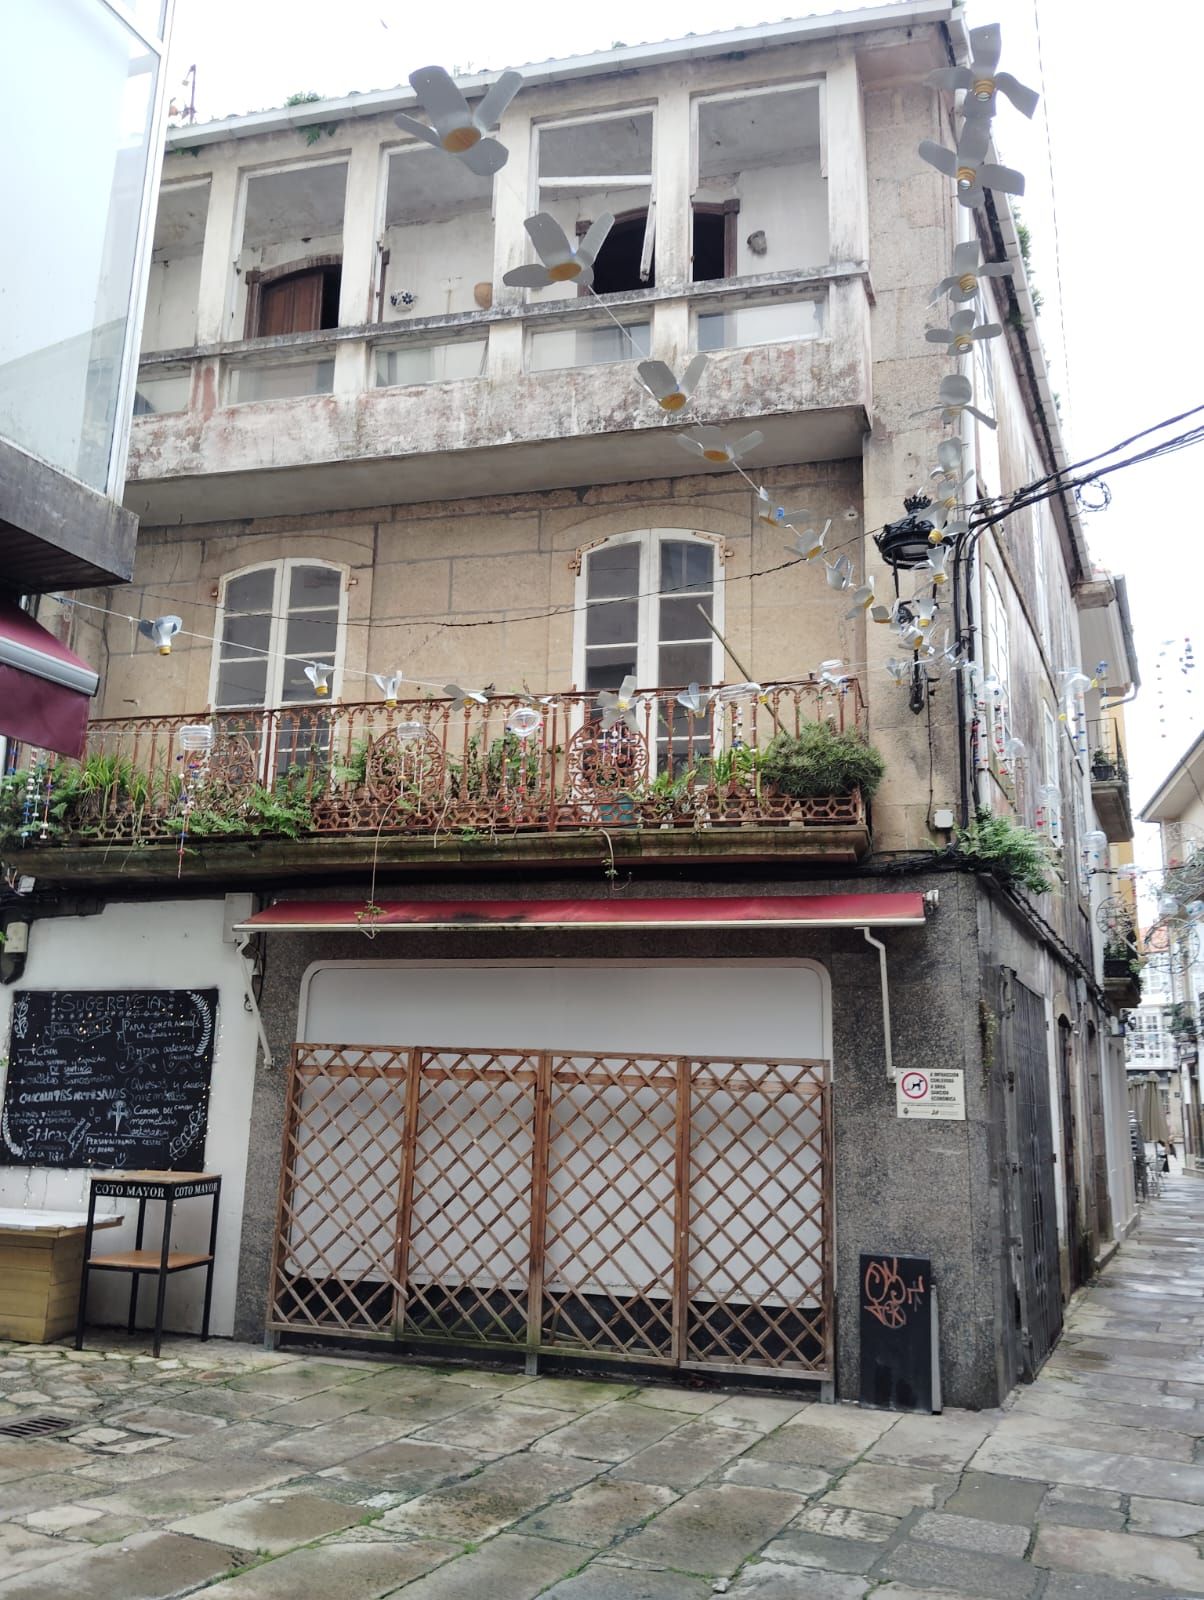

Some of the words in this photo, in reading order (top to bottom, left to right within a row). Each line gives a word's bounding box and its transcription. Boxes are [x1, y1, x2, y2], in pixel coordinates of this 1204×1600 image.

[95, 1184, 123, 1195] COTO
[126, 1185, 164, 1198] MAYOR
[174, 1185, 193, 1197] COTO
[194, 1182, 218, 1194] MAYOR
